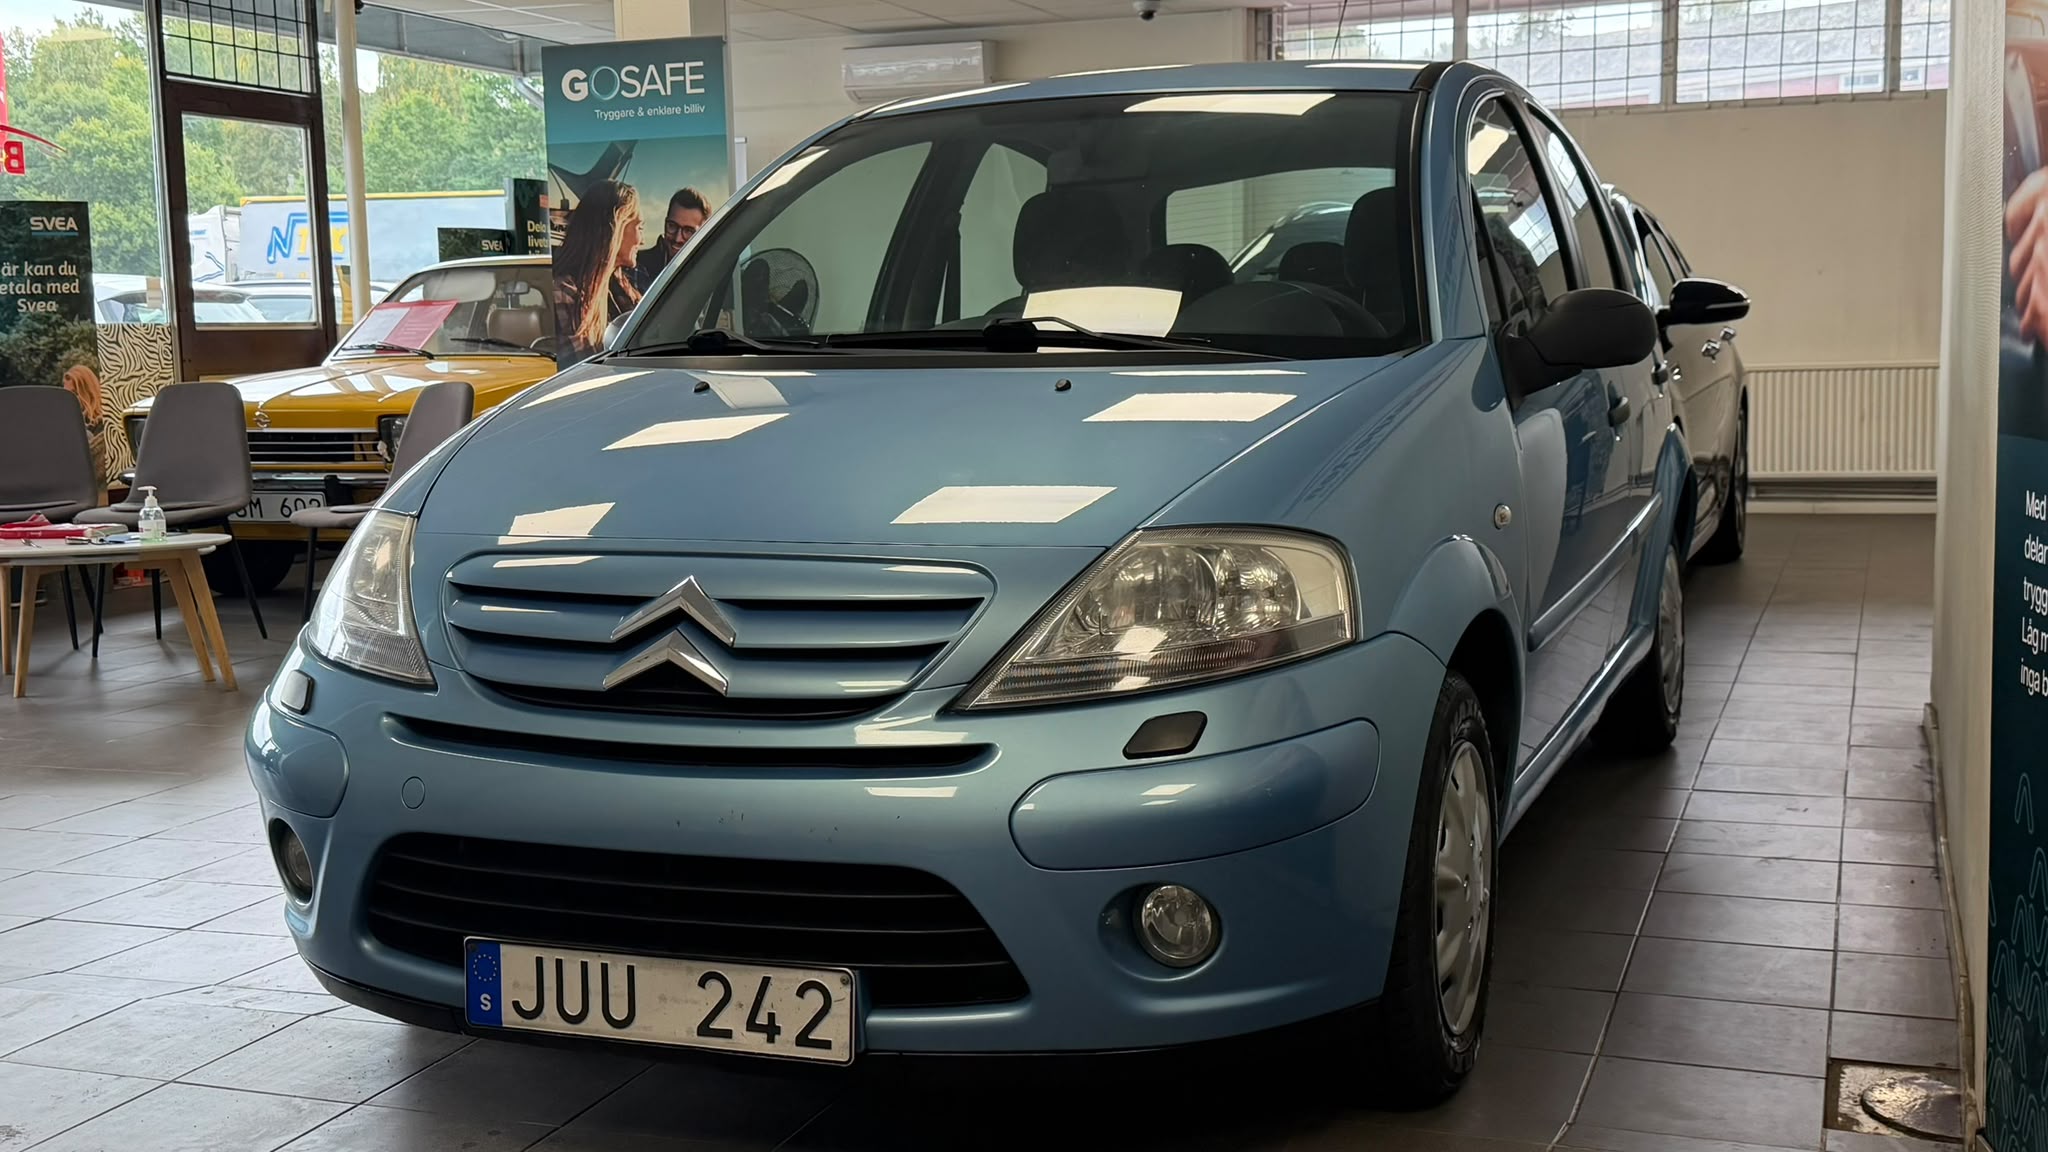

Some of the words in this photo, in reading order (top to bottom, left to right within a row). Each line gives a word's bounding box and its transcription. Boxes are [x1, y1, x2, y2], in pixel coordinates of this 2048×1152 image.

[561, 61, 705, 102] GOSAFE
[594, 109, 635, 121] Tryggare
[637, 107, 645, 117] &
[647, 105, 682, 116] enklare
[684, 103, 706, 114] billiv
[29, 216, 79, 231] SVEA
[481, 239, 504, 251] SVEA
[1, 262, 19, 276] är
[24, 261, 55, 276] kan
[58, 261, 77, 276] du
[0, 279, 42, 295] etala
[46, 279, 80, 294] med
[17, 299, 57, 313] Svea
[2025, 489, 2047, 521] Med
[2023, 576, 2048, 616] trygg
[2021, 616, 2039, 655] Låg
[2020, 657, 2040, 696] inga
[2042, 669, 2048, 697] b
[480, 993, 492, 1012] S
[511, 956, 637, 1029] JUU
[696, 971, 833, 1050] 242
